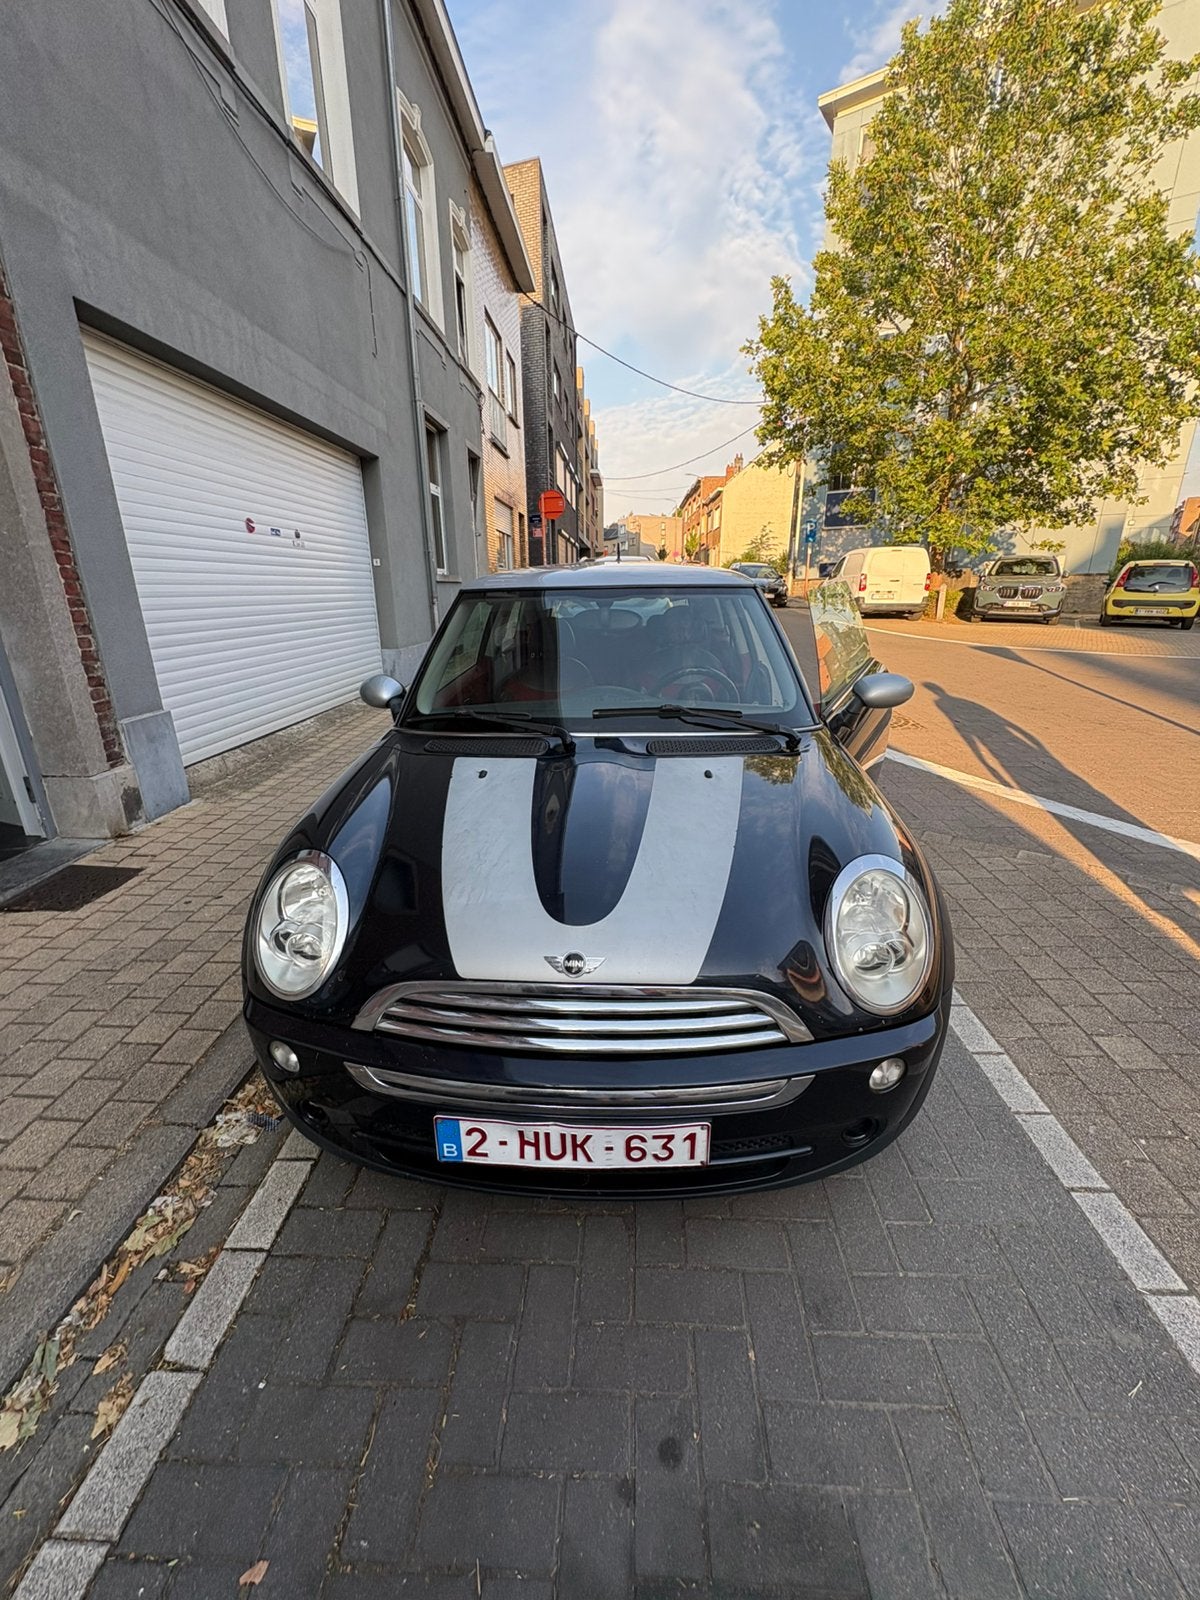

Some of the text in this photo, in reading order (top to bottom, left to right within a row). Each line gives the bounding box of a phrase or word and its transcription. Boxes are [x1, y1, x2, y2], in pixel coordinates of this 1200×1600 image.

[807, 522, 816, 535] P
[564, 960, 584, 968] MINI
[443, 1143, 458, 1157] B
